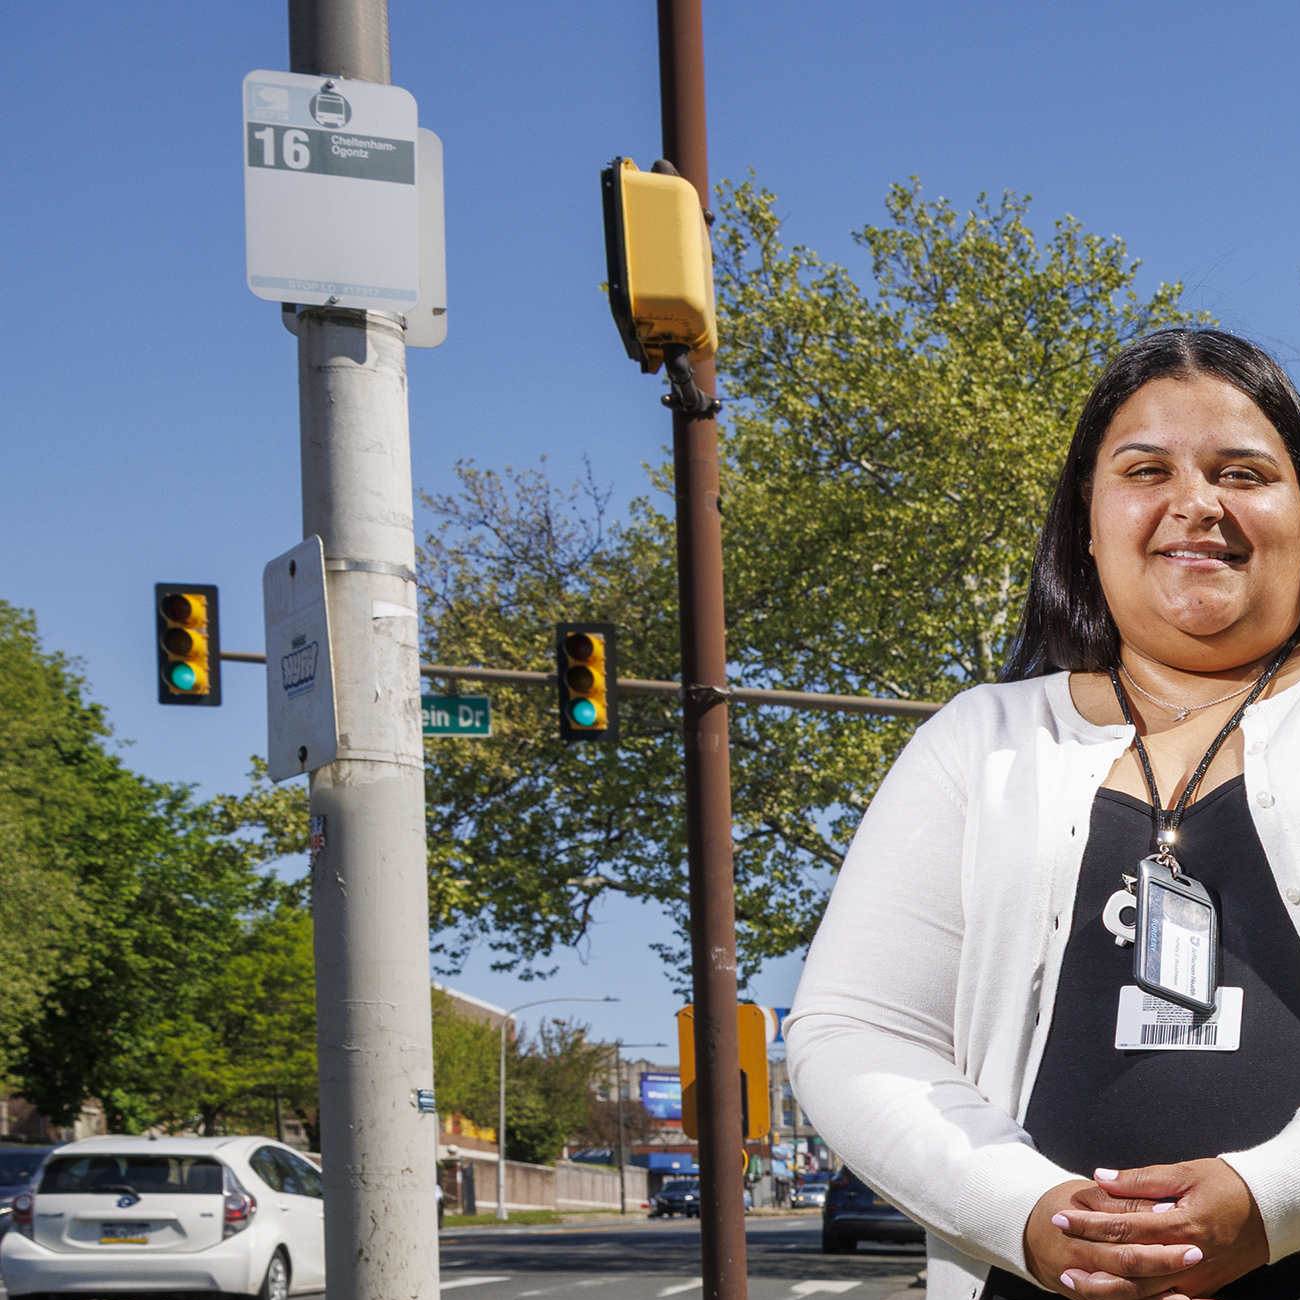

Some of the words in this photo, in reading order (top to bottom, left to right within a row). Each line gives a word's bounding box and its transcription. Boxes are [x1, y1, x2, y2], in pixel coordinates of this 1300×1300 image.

[254, 126, 311, 170] 16
[331, 134, 397, 152] Cheltenham-
[331, 145, 370, 160] Ogontz
[288, 280, 319, 292] STOP
[421, 705, 450, 727] ein
[458, 705, 485, 728] Dr
[1189, 975, 1197, 997] Health
